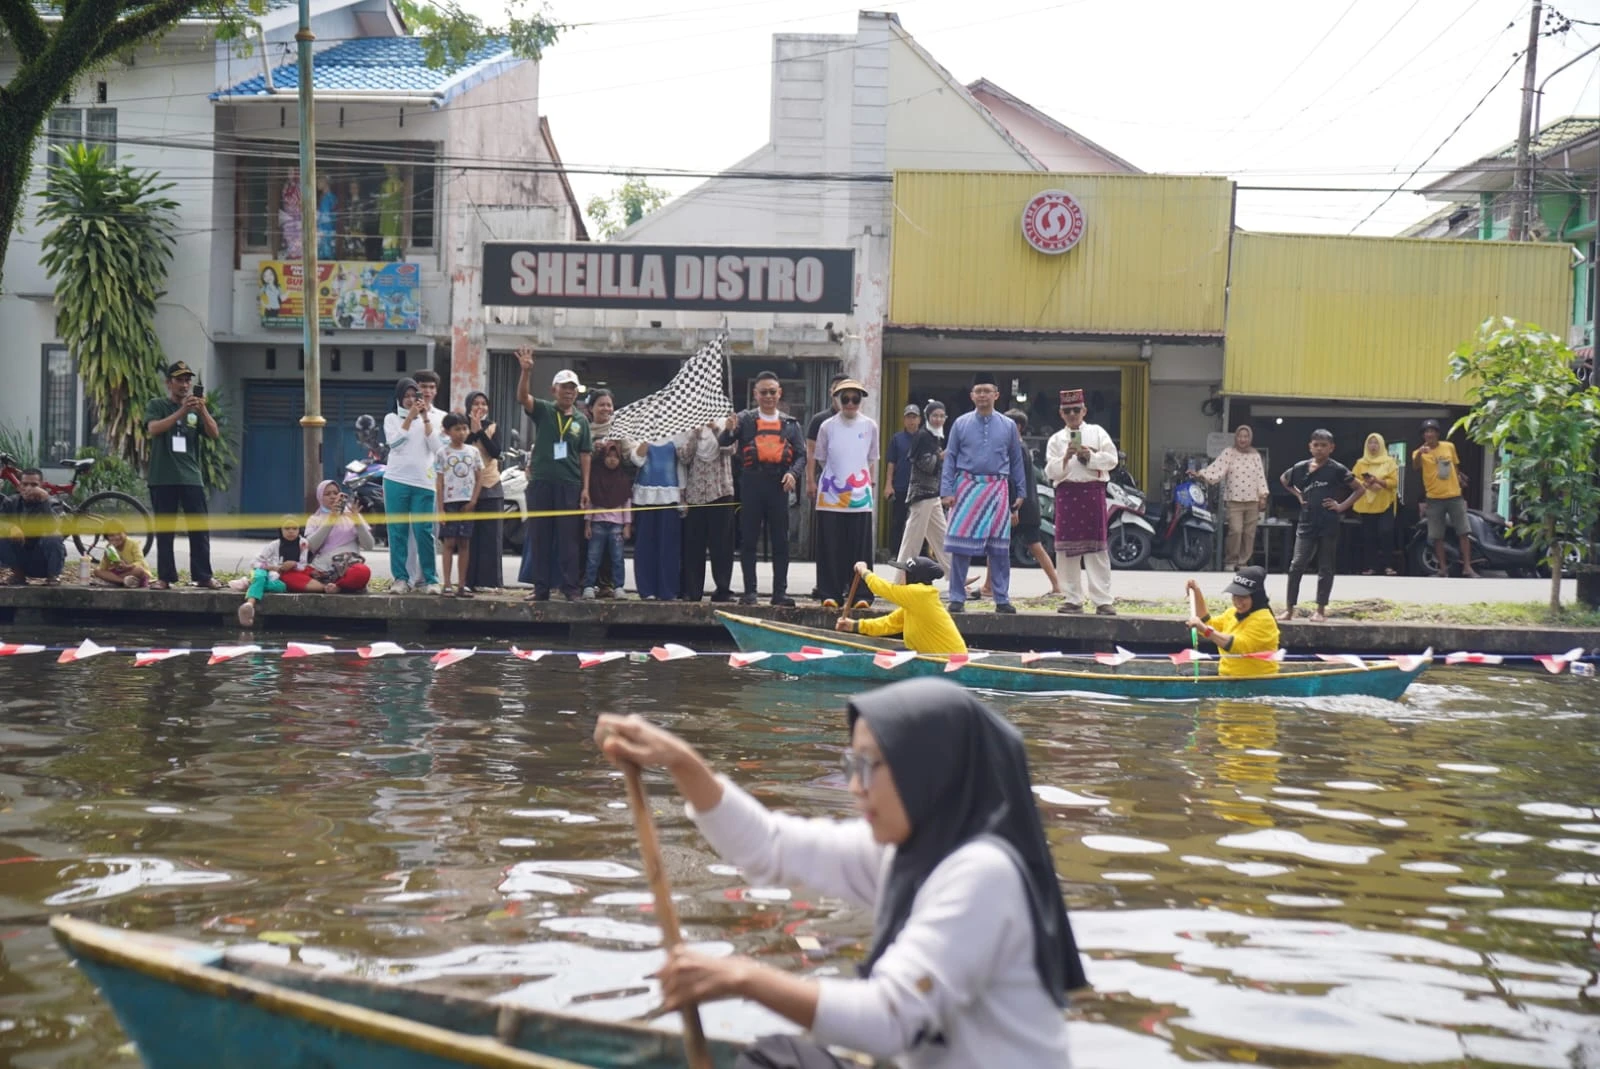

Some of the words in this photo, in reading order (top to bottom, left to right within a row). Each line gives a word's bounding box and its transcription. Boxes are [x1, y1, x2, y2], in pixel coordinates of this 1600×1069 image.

[510, 250, 667, 300] SHEILLA
[674, 255, 824, 303] DISTRO
[1234, 575, 1256, 587] ORT
